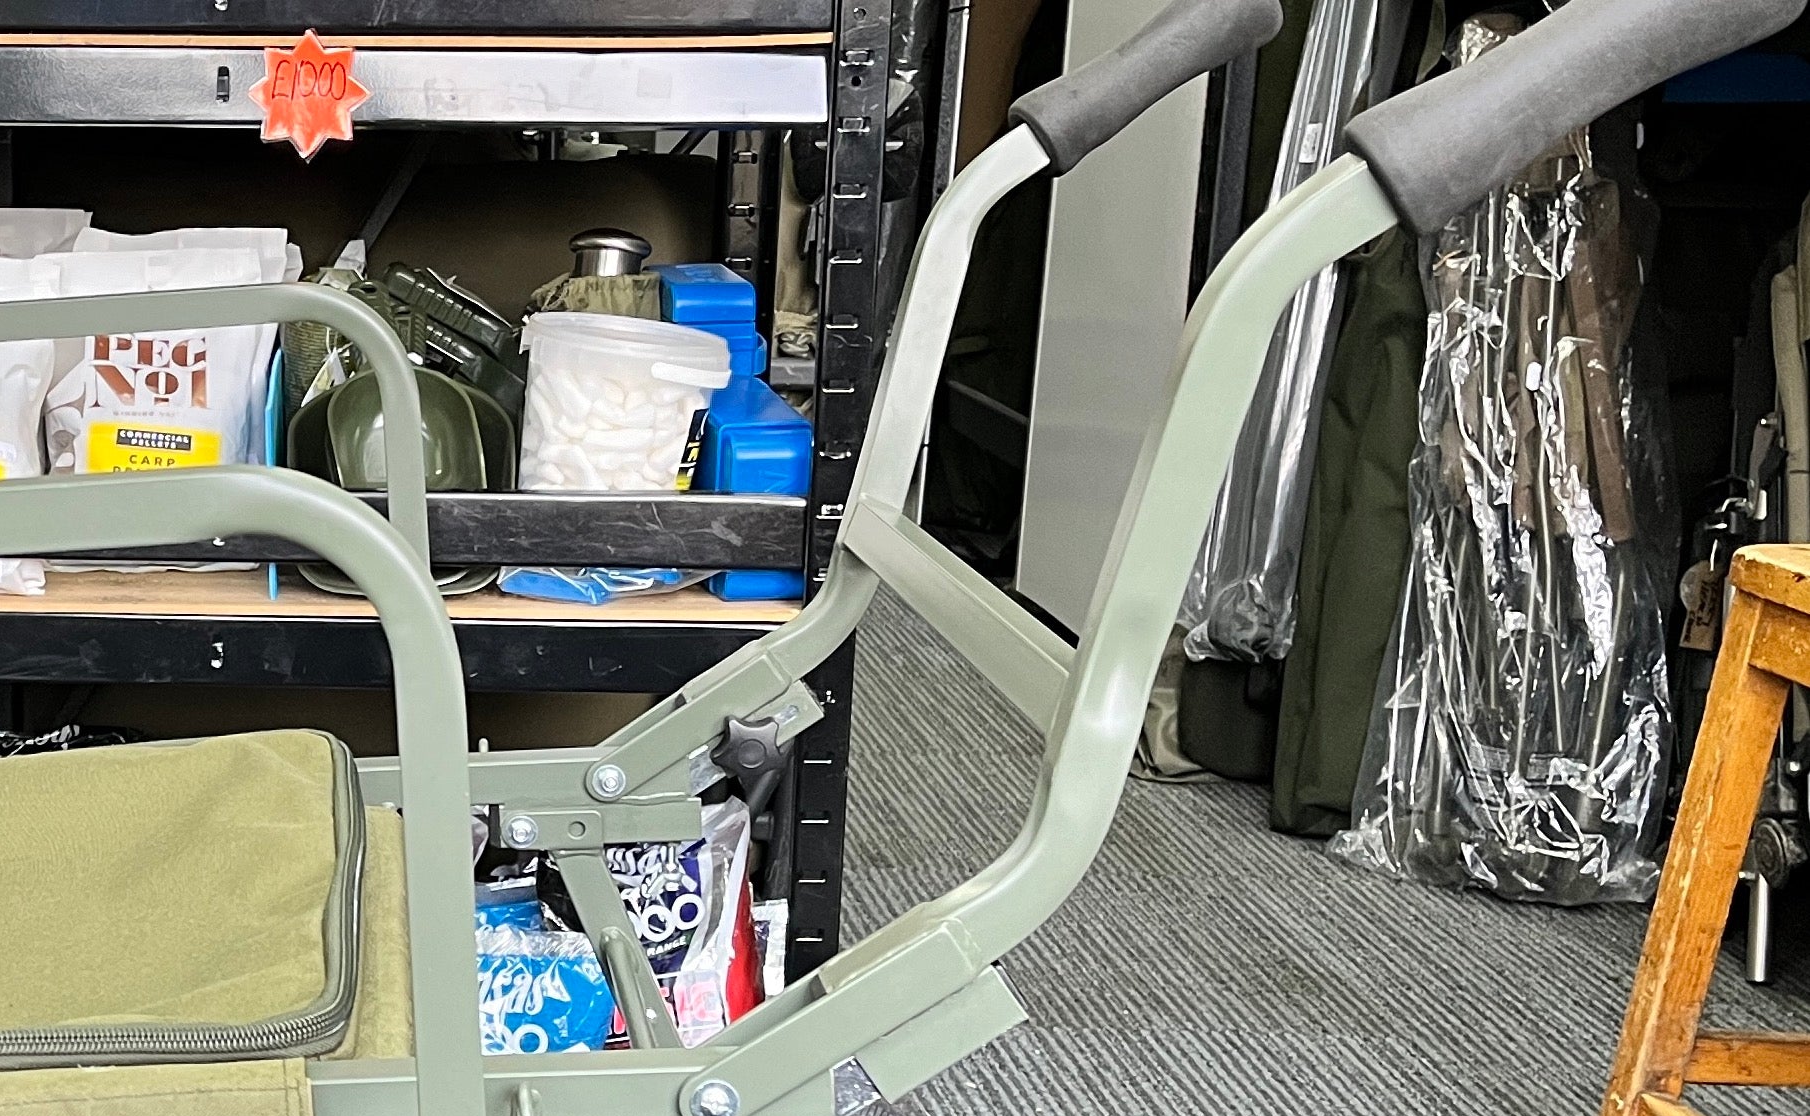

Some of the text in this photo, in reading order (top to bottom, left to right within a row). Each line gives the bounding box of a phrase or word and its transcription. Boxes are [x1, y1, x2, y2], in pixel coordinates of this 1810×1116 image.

[94, 334, 207, 368] PEG
[119, 429, 190, 444] COMMERCIAL
[129, 454, 176, 466] CARP
[646, 935, 687, 957] RANGE
